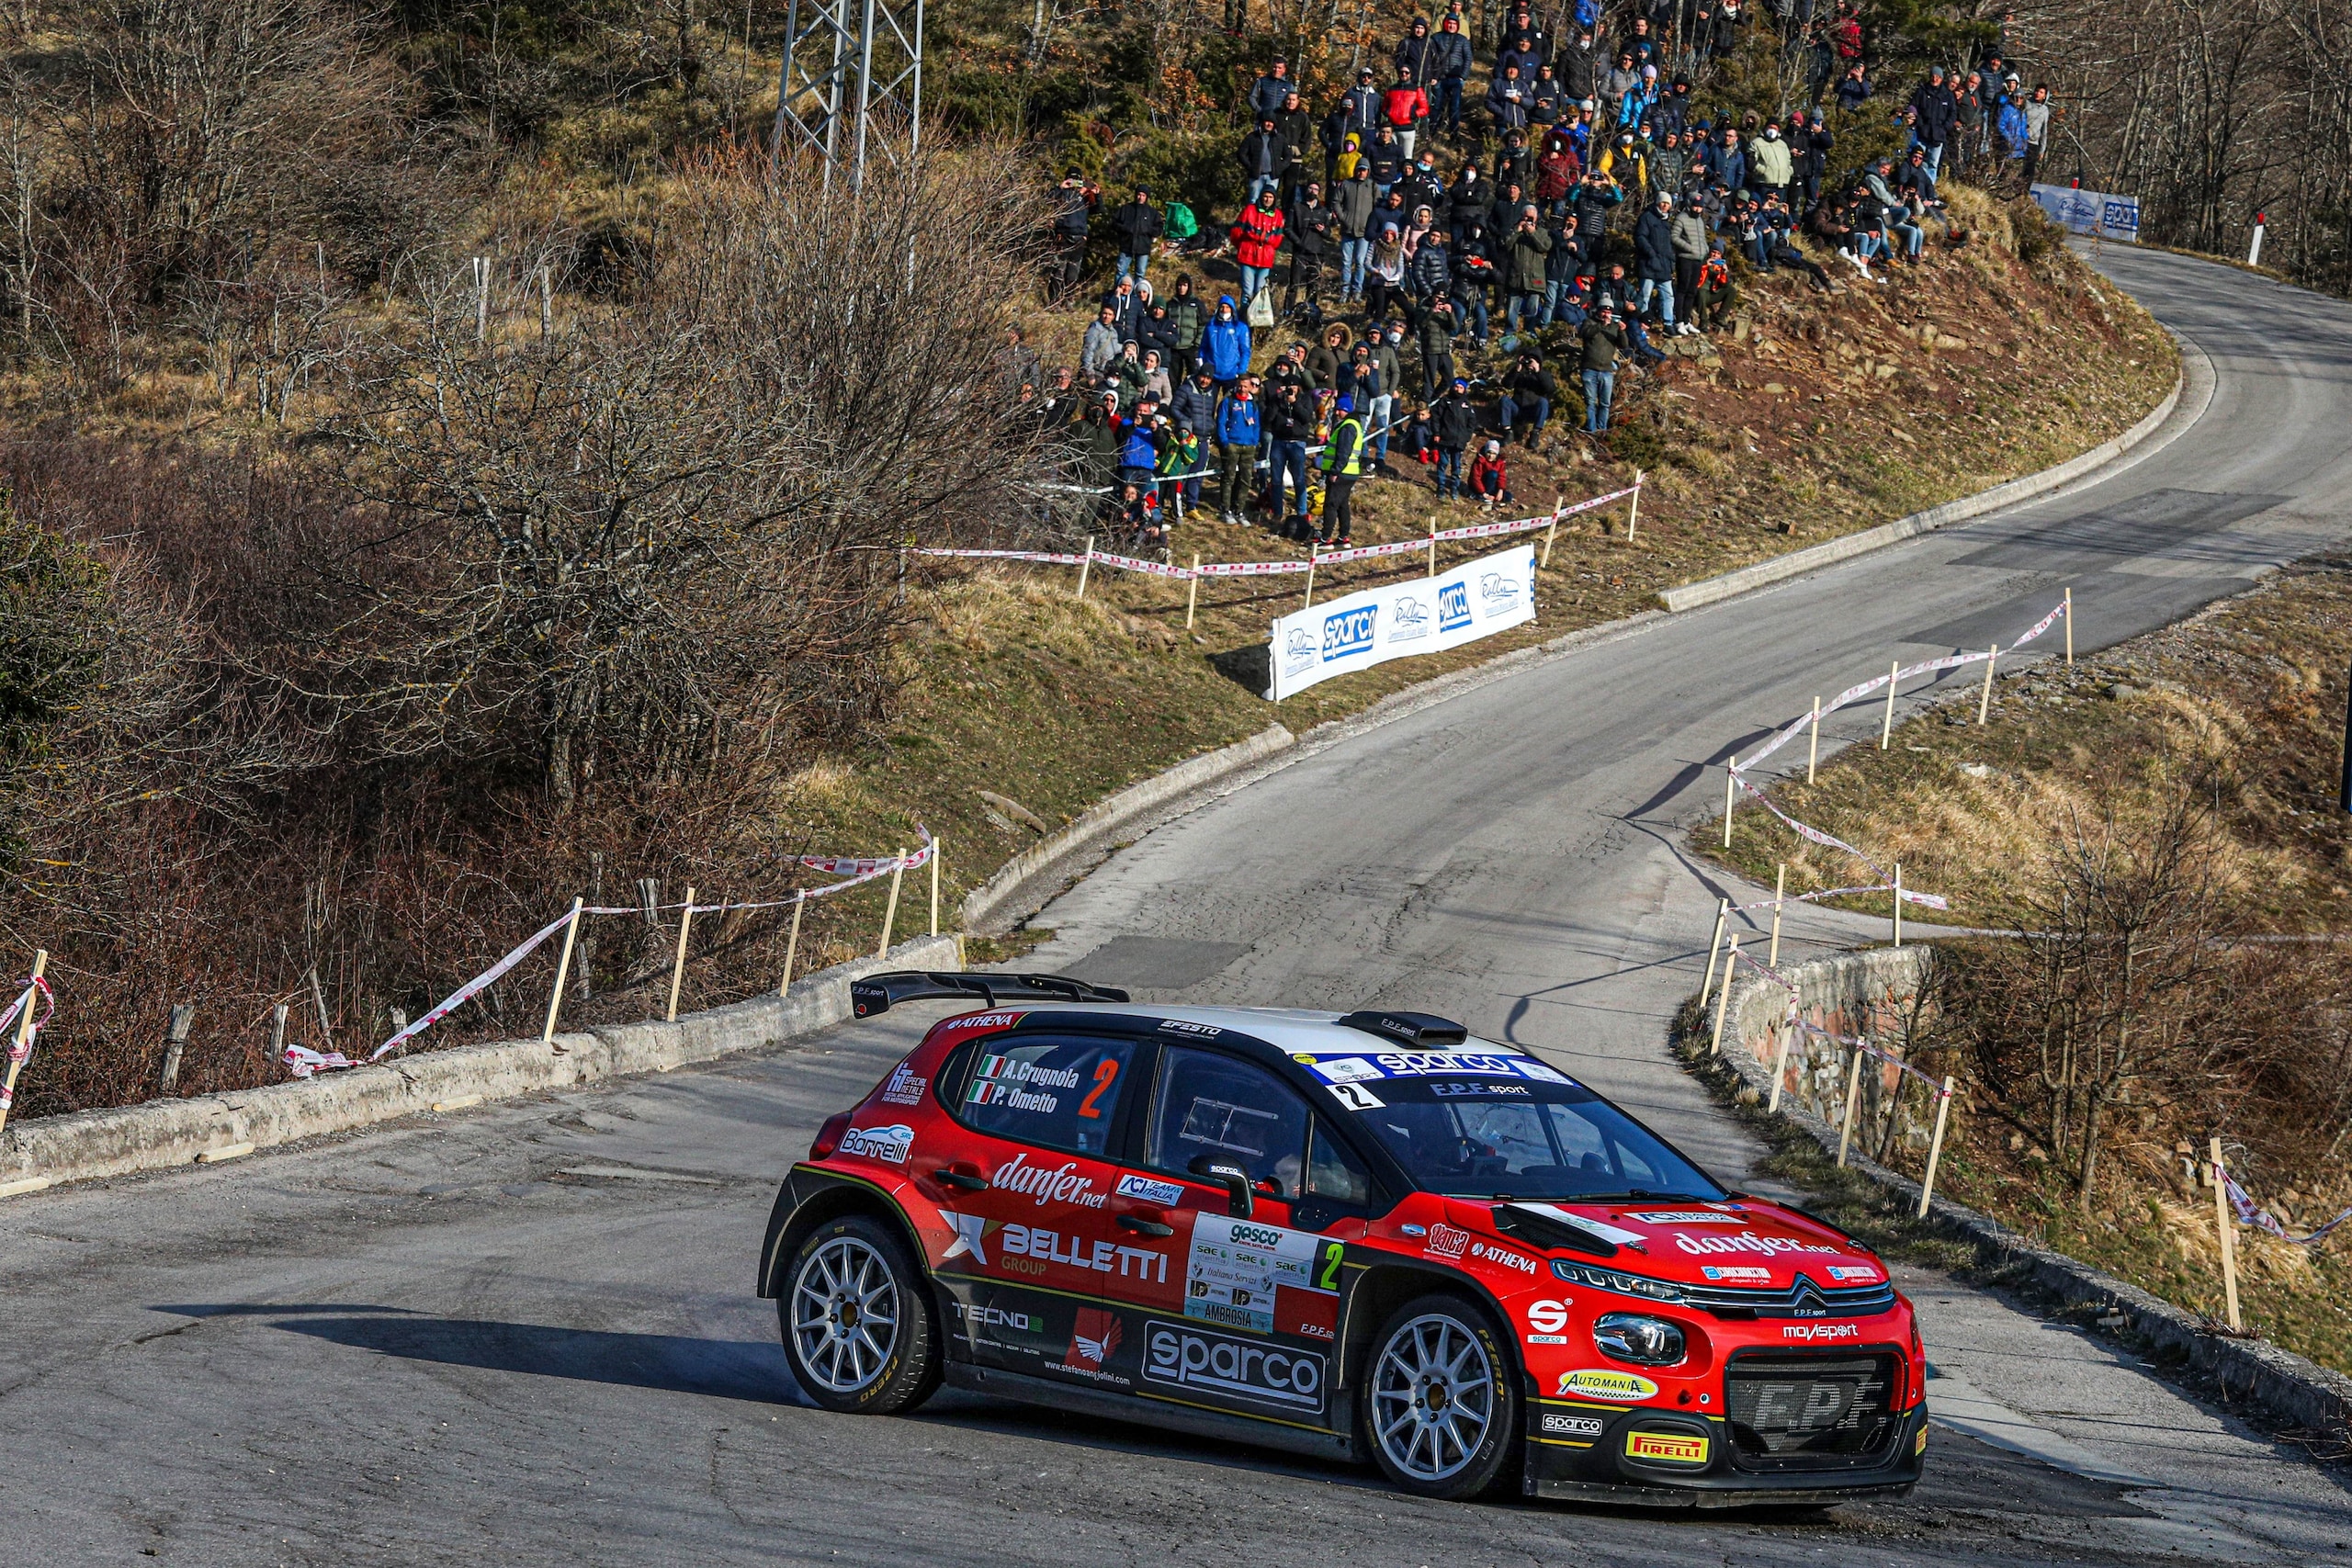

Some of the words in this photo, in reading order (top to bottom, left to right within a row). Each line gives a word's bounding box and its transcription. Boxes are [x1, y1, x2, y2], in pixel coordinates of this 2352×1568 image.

[958, 1014, 1013, 1028] ATHENA
[1160, 1021, 1223, 1035] EFESTO
[1002, 1060, 1079, 1089] A.Crugnola
[1376, 1054, 1511, 1076] sparco
[991, 1085, 1004, 1105] P.
[1008, 1090, 1057, 1113] Ometto
[1078, 1058, 1119, 1120] 2
[1335, 1085, 1374, 1108] 2
[900, 1132, 912, 1140] SRL
[1210, 1164, 1238, 1174] sparco
[1143, 1188, 1173, 1201] ITALIA
[1230, 1224, 1279, 1246] gesco
[1001, 1223, 1168, 1283] BELLETTI
[1482, 1247, 1537, 1275] ATHENA
[1001, 1256, 1047, 1277] GROUP
[1320, 1243, 1344, 1291] 2
[1204, 1304, 1251, 1328] AMBROSIA
[1151, 1331, 1318, 1394] sparco
[1562, 1373, 1643, 1393] AUTOMANIA
[1545, 1416, 1600, 1430] sparco
[1634, 1436, 1702, 1458] PIRELLI
